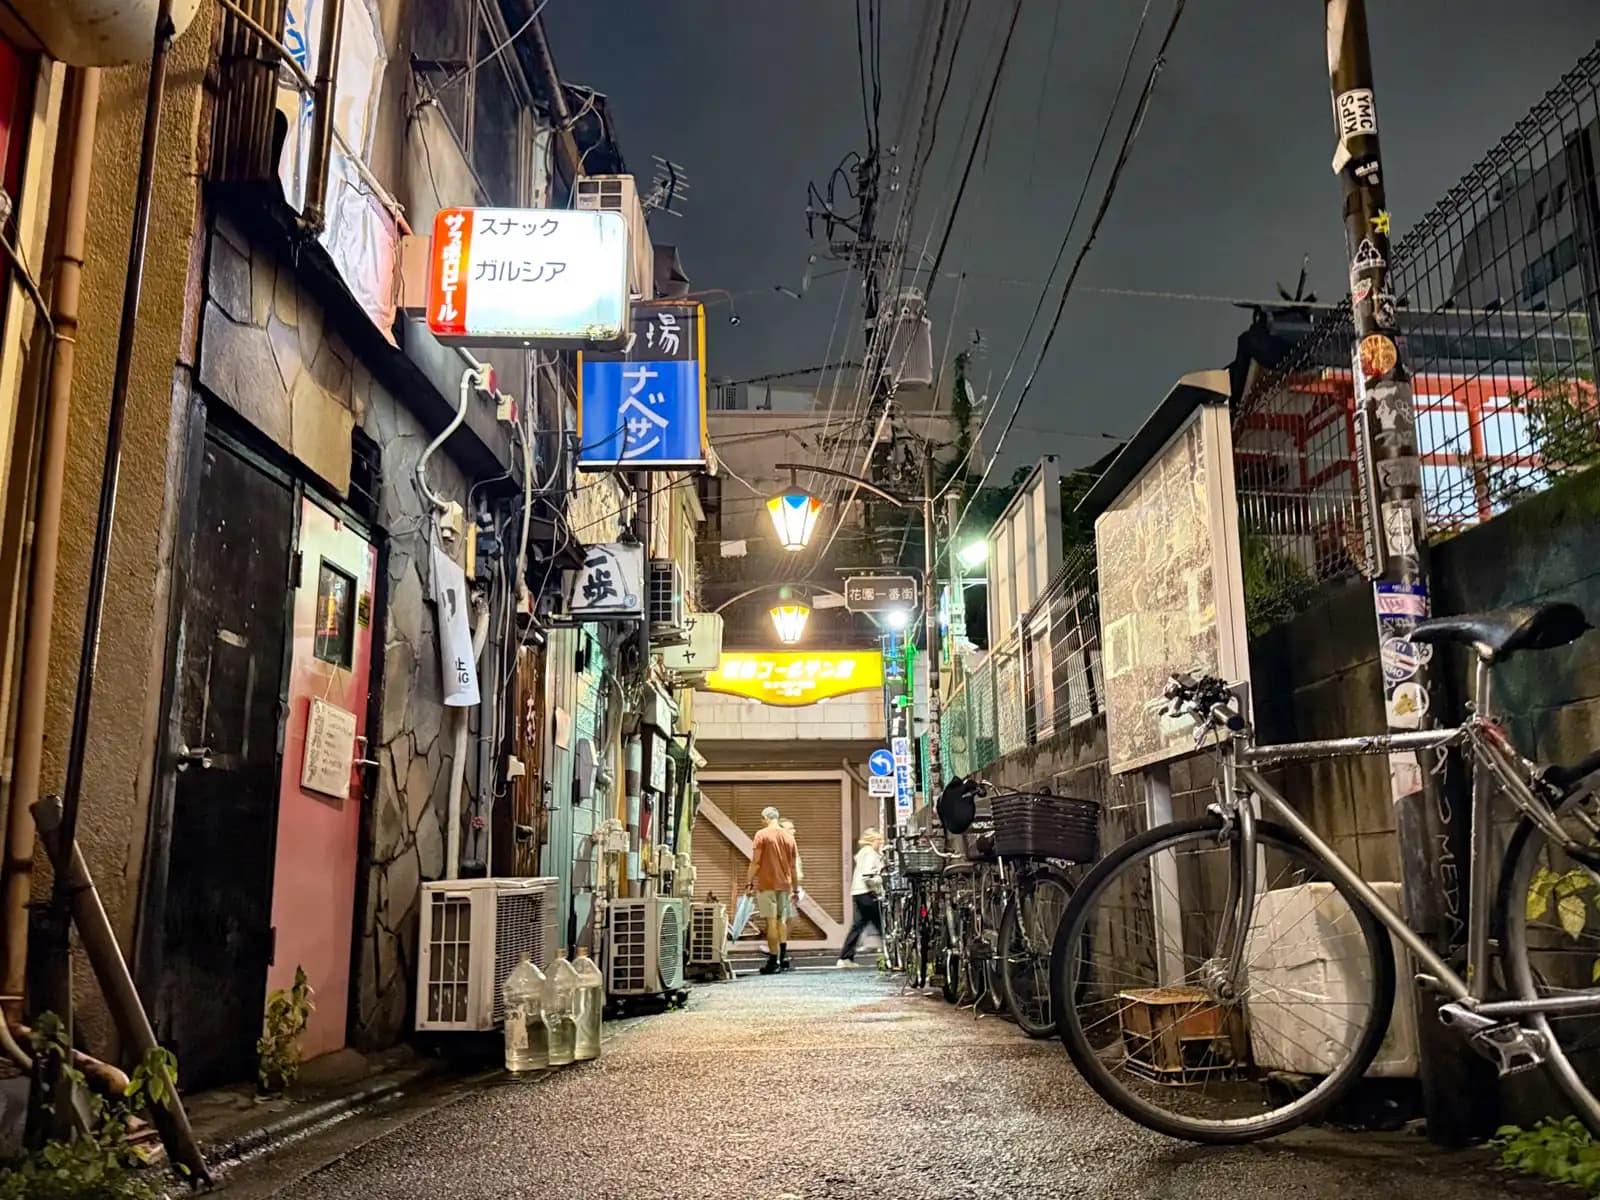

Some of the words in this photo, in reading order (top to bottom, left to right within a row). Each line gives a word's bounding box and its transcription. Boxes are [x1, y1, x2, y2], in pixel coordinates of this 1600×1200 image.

[1357, 94, 1373, 129] YMC
[479, 217, 559, 237] スナック
[475, 260, 567, 283] ガルシア
[582, 555, 618, 607] 一歩
